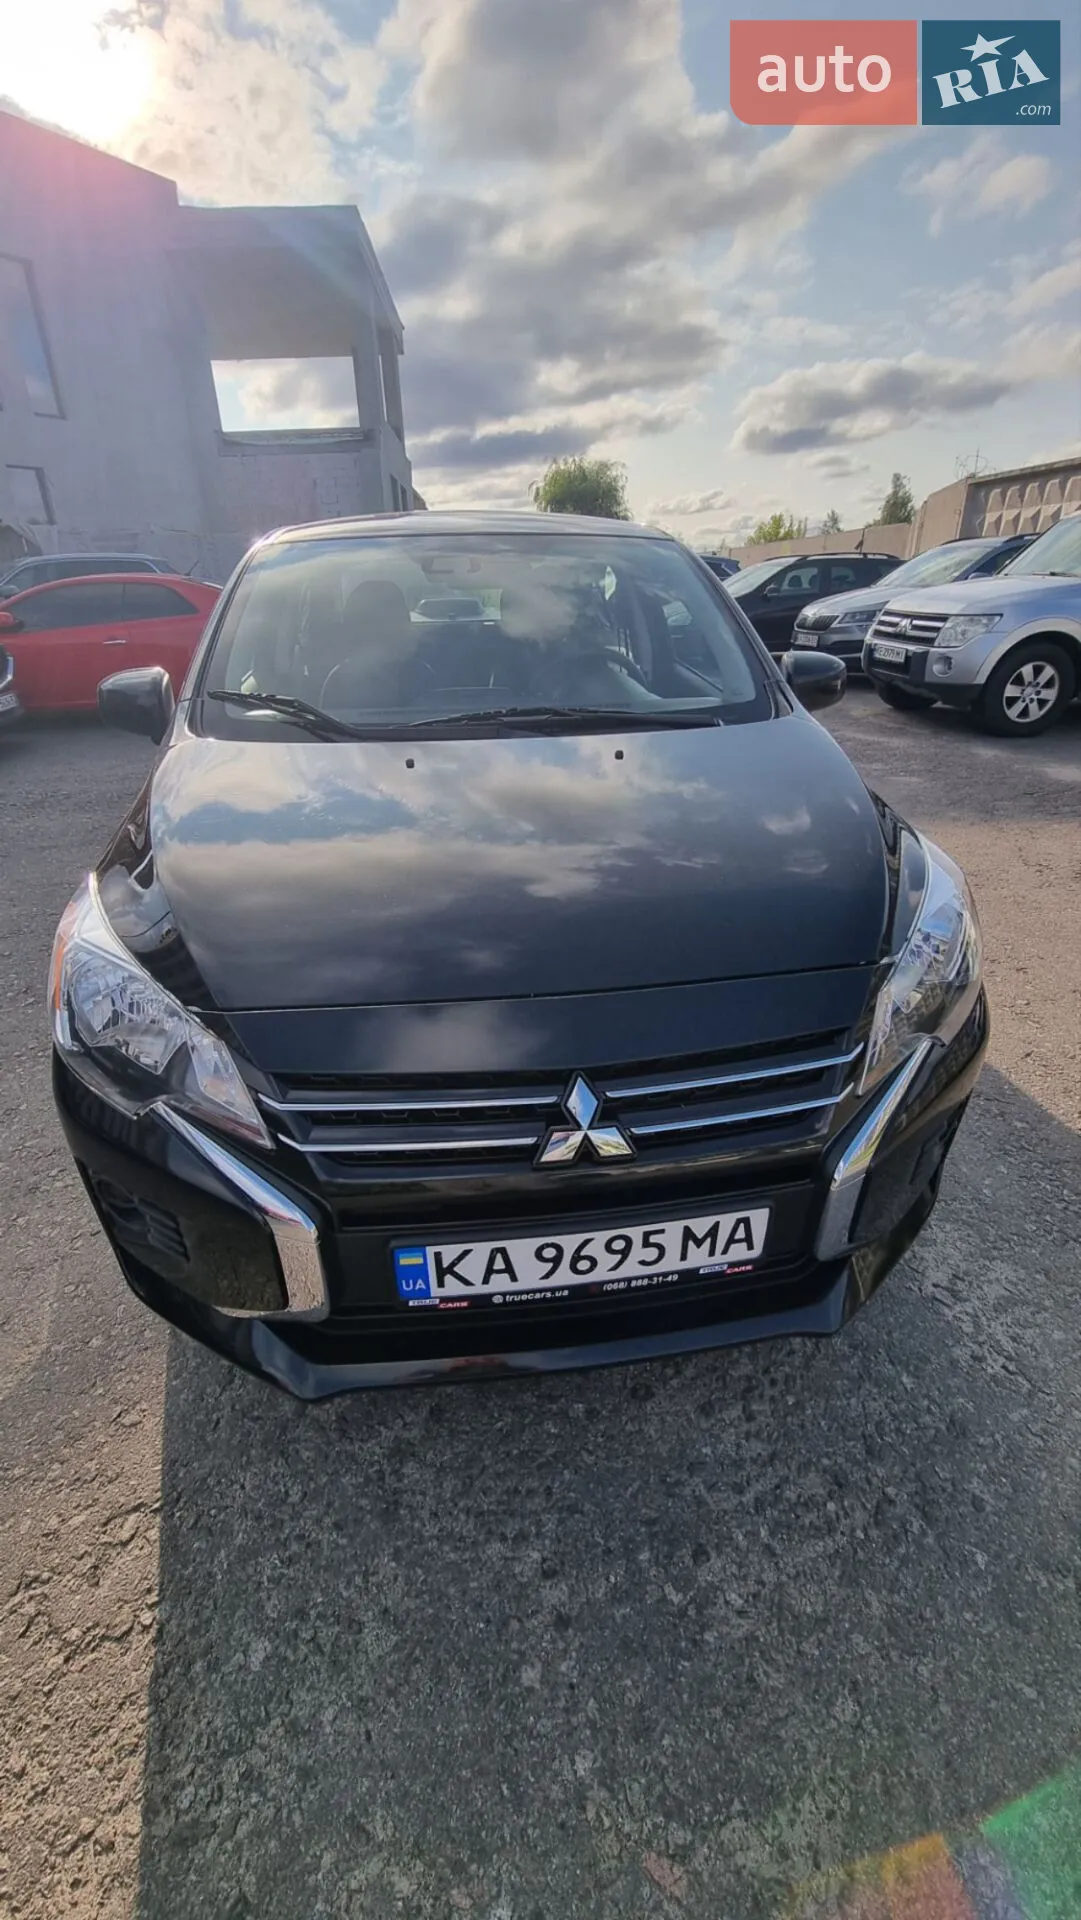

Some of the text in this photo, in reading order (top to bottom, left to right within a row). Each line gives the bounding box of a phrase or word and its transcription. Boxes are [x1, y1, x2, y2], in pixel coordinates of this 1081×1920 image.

[433, 1215, 755, 1289] KA 9695 MA
[402, 1278, 427, 1291] UA
